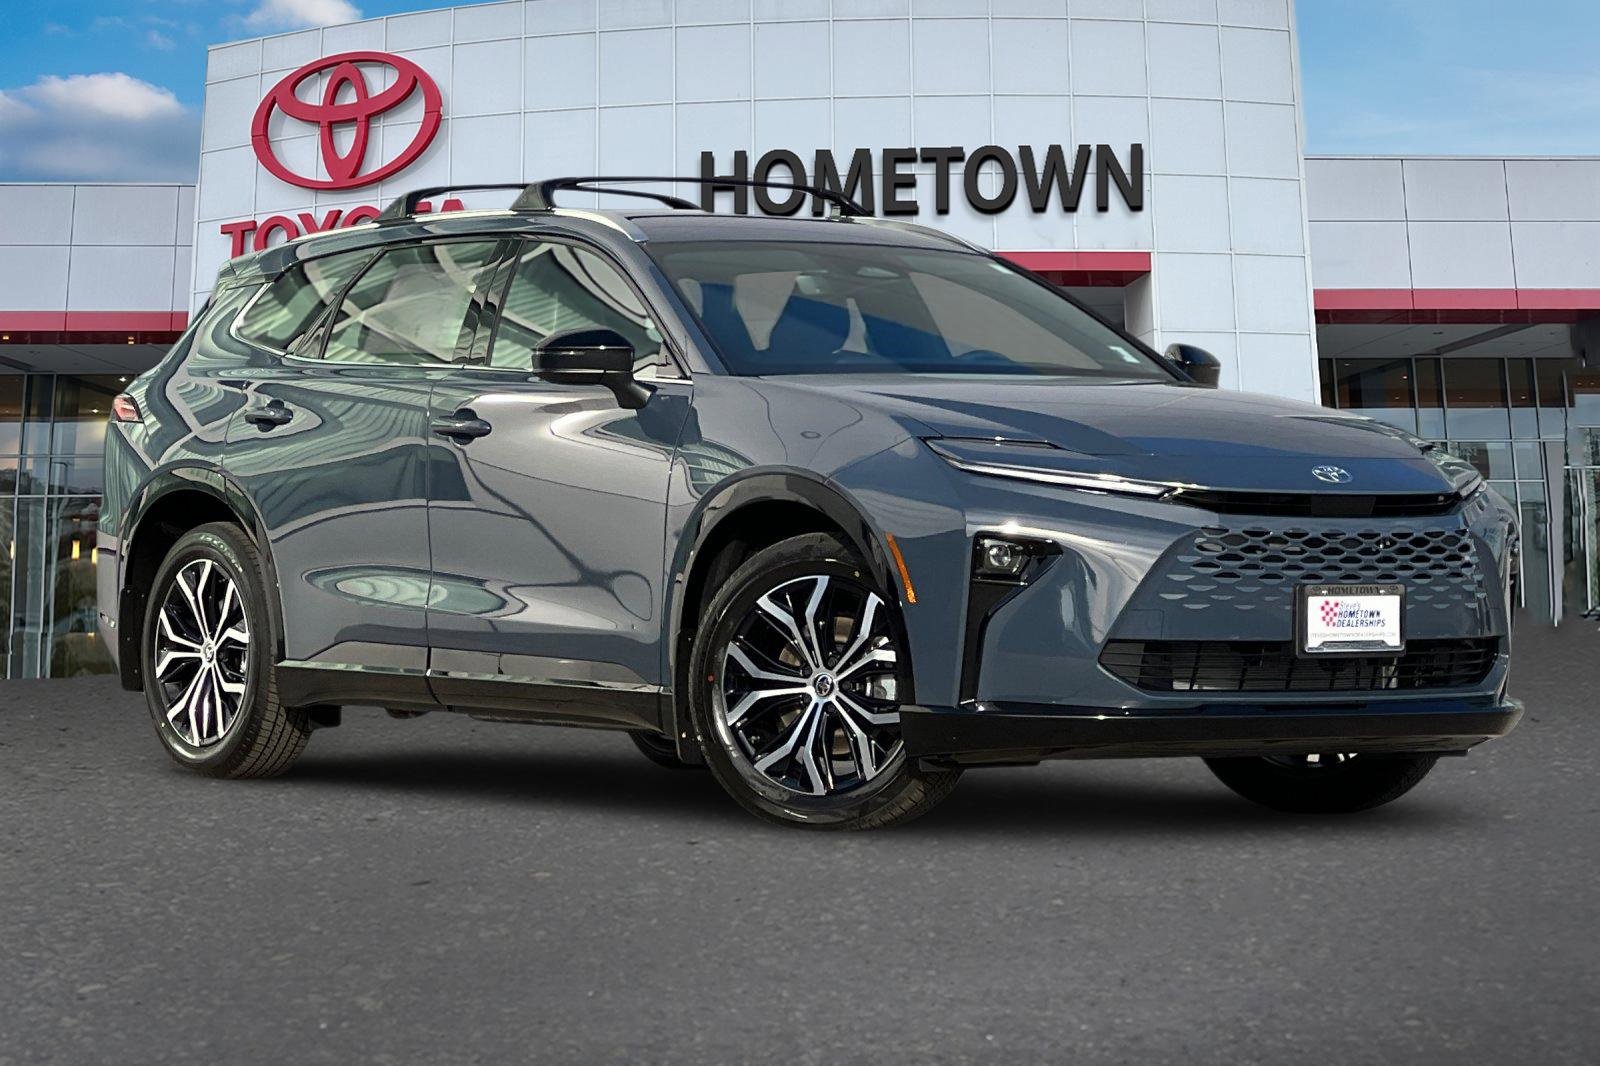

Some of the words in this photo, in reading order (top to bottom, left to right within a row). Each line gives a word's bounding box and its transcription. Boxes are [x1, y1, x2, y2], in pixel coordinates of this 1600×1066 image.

[700, 143, 1144, 217] HOMETOWN
[1328, 586, 1380, 595] HOMETOWN
[1338, 610, 1381, 619] HOMETOWN
[1336, 619, 1386, 628] DEALERSHIPS
